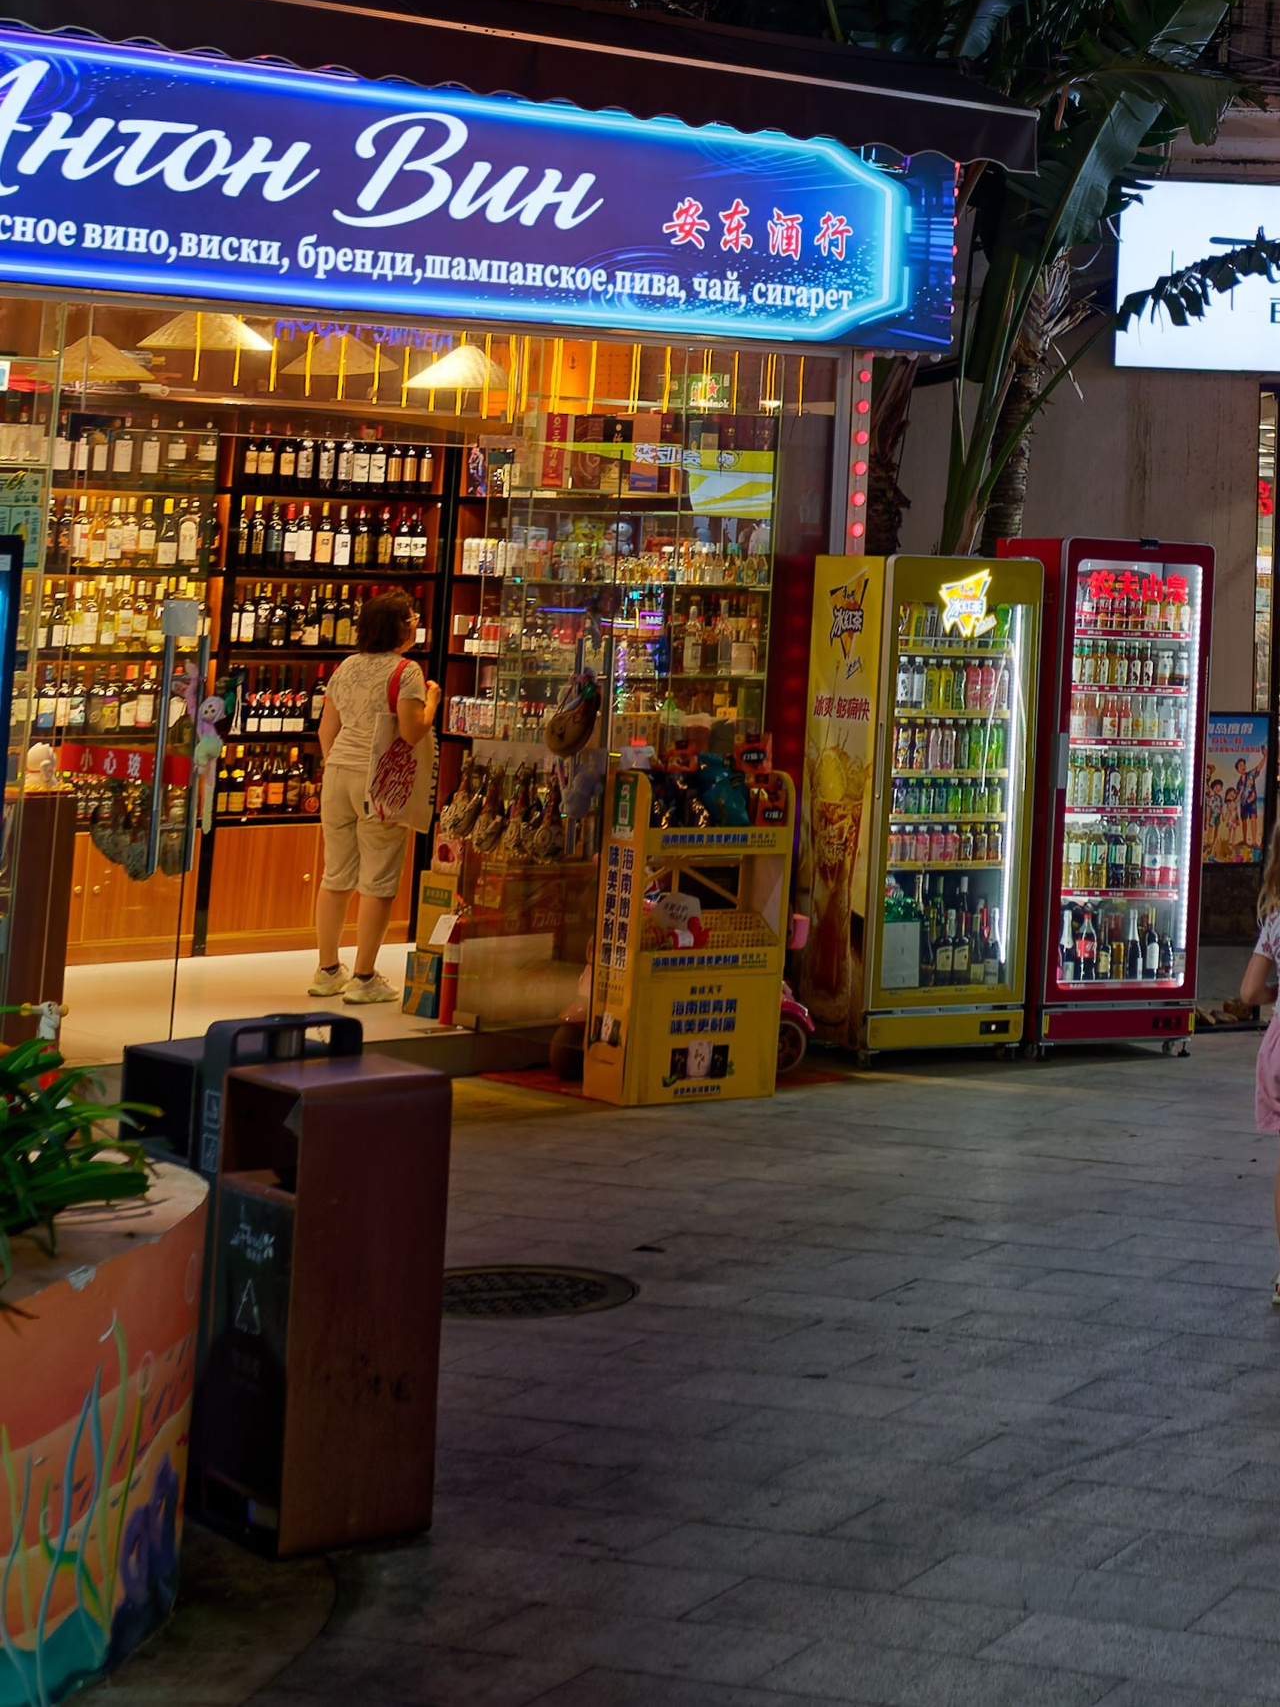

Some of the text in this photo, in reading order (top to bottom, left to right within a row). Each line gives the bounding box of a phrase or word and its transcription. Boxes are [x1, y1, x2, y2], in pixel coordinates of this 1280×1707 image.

[333, 112, 604, 228] Вин
[663, 197, 854, 261] 安东酒行
[693, 270, 747, 304] чай,
[753, 281, 854, 315] сигарет
[1088, 569, 1188, 603] 农夫山泉
[80, 748, 155, 778] 小心玻
